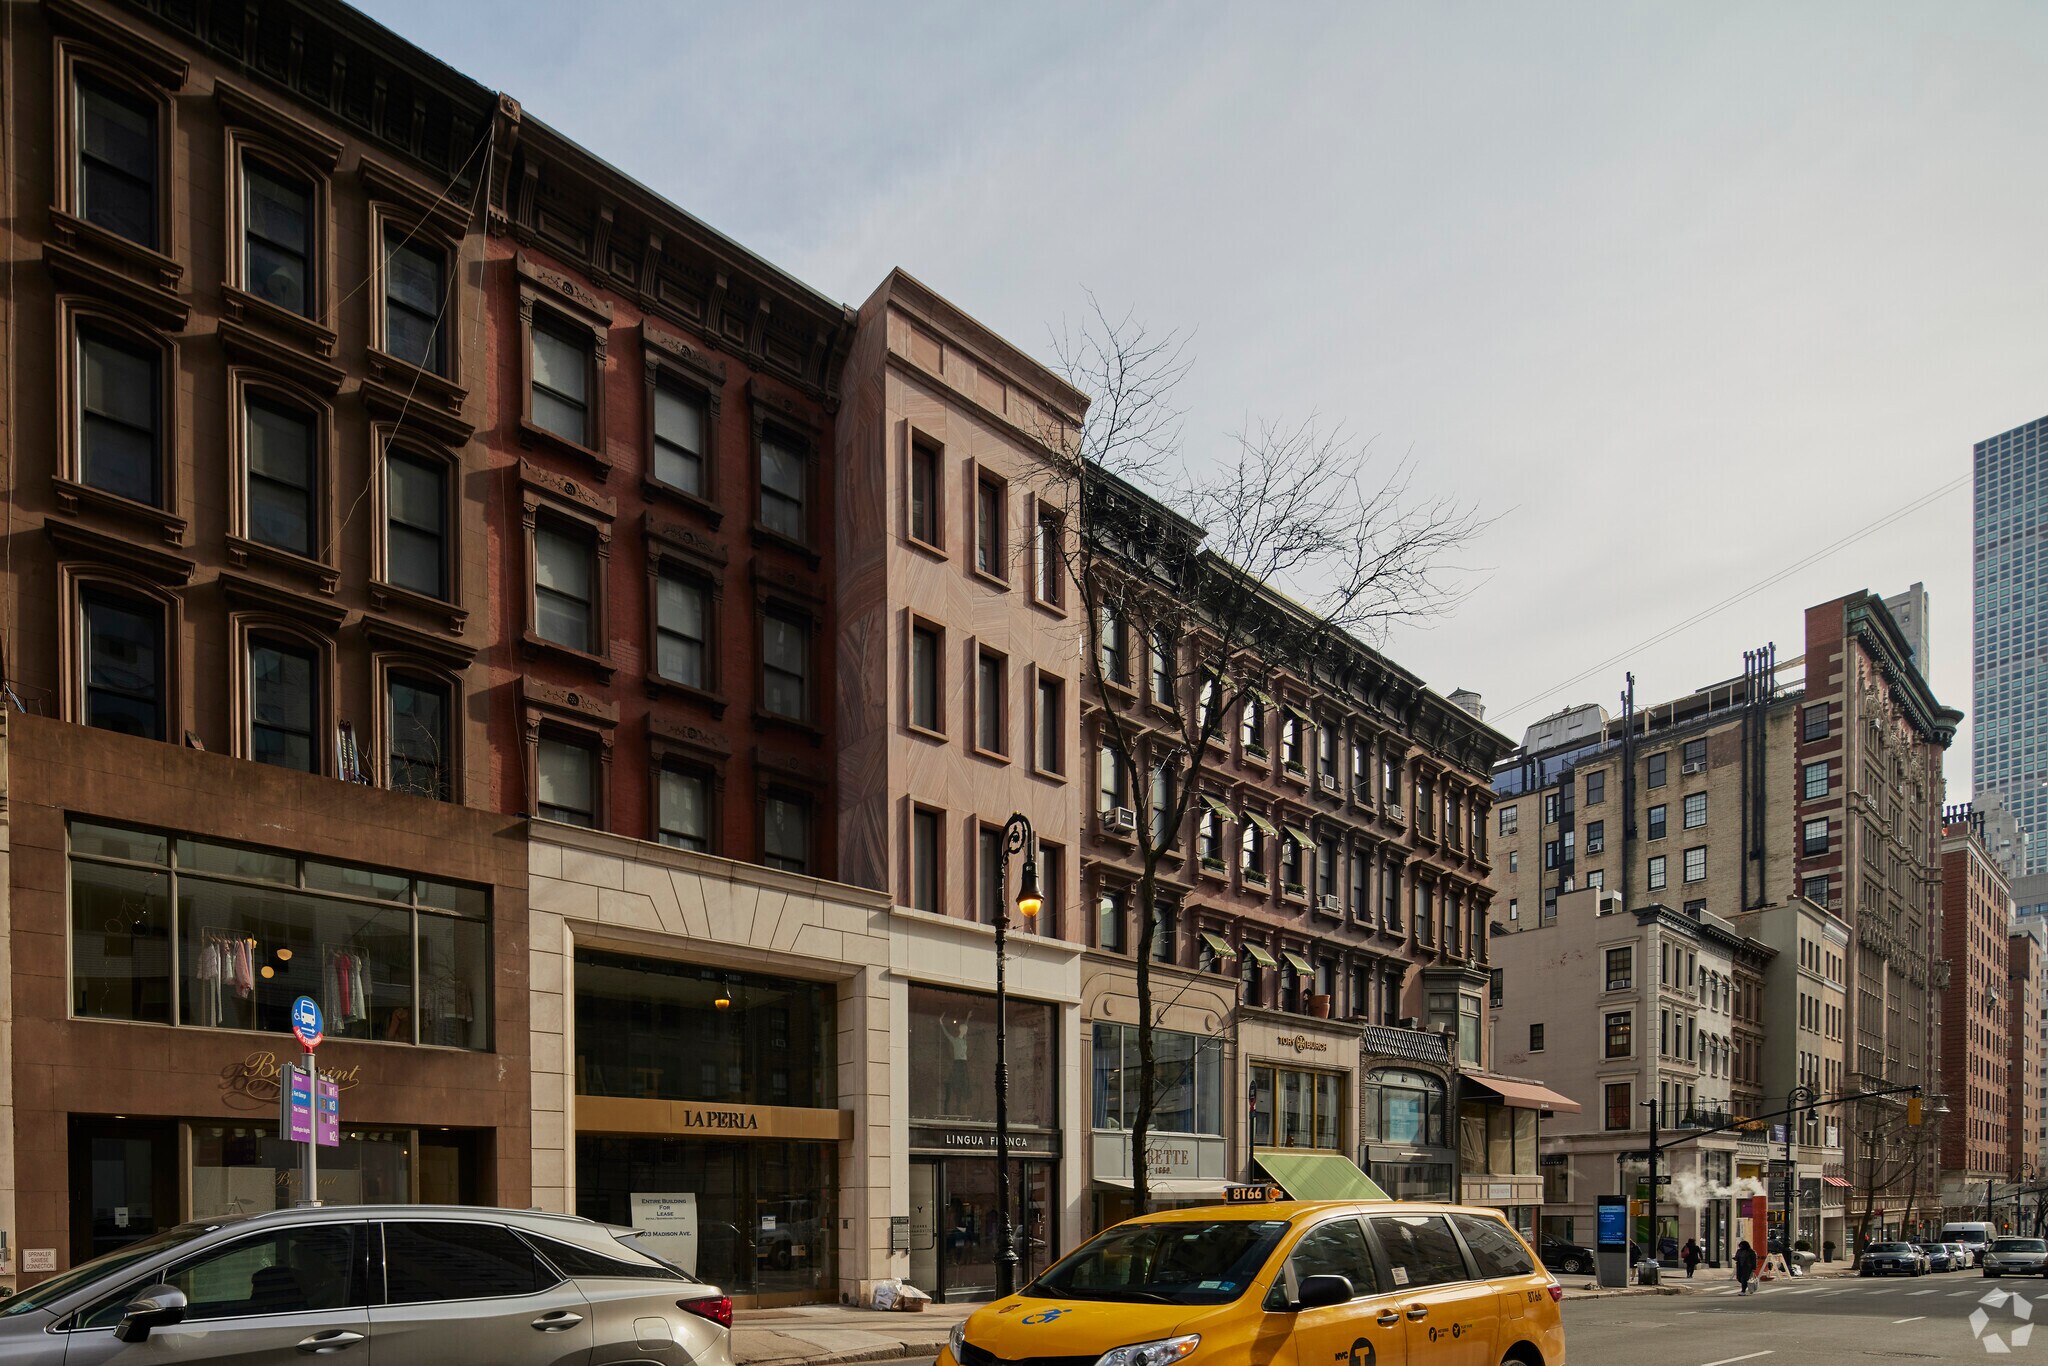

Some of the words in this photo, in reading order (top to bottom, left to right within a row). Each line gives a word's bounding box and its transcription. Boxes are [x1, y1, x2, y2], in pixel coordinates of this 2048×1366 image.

[684, 1110, 704, 1128] LA
[706, 1111, 758, 1129] PERLA
[946, 1134, 984, 1145] LINGUA
[1233, 1187, 1262, 1200] 8T66
[1527, 1290, 1543, 1303] 8T66
[1334, 1351, 1349, 1361] NYC
